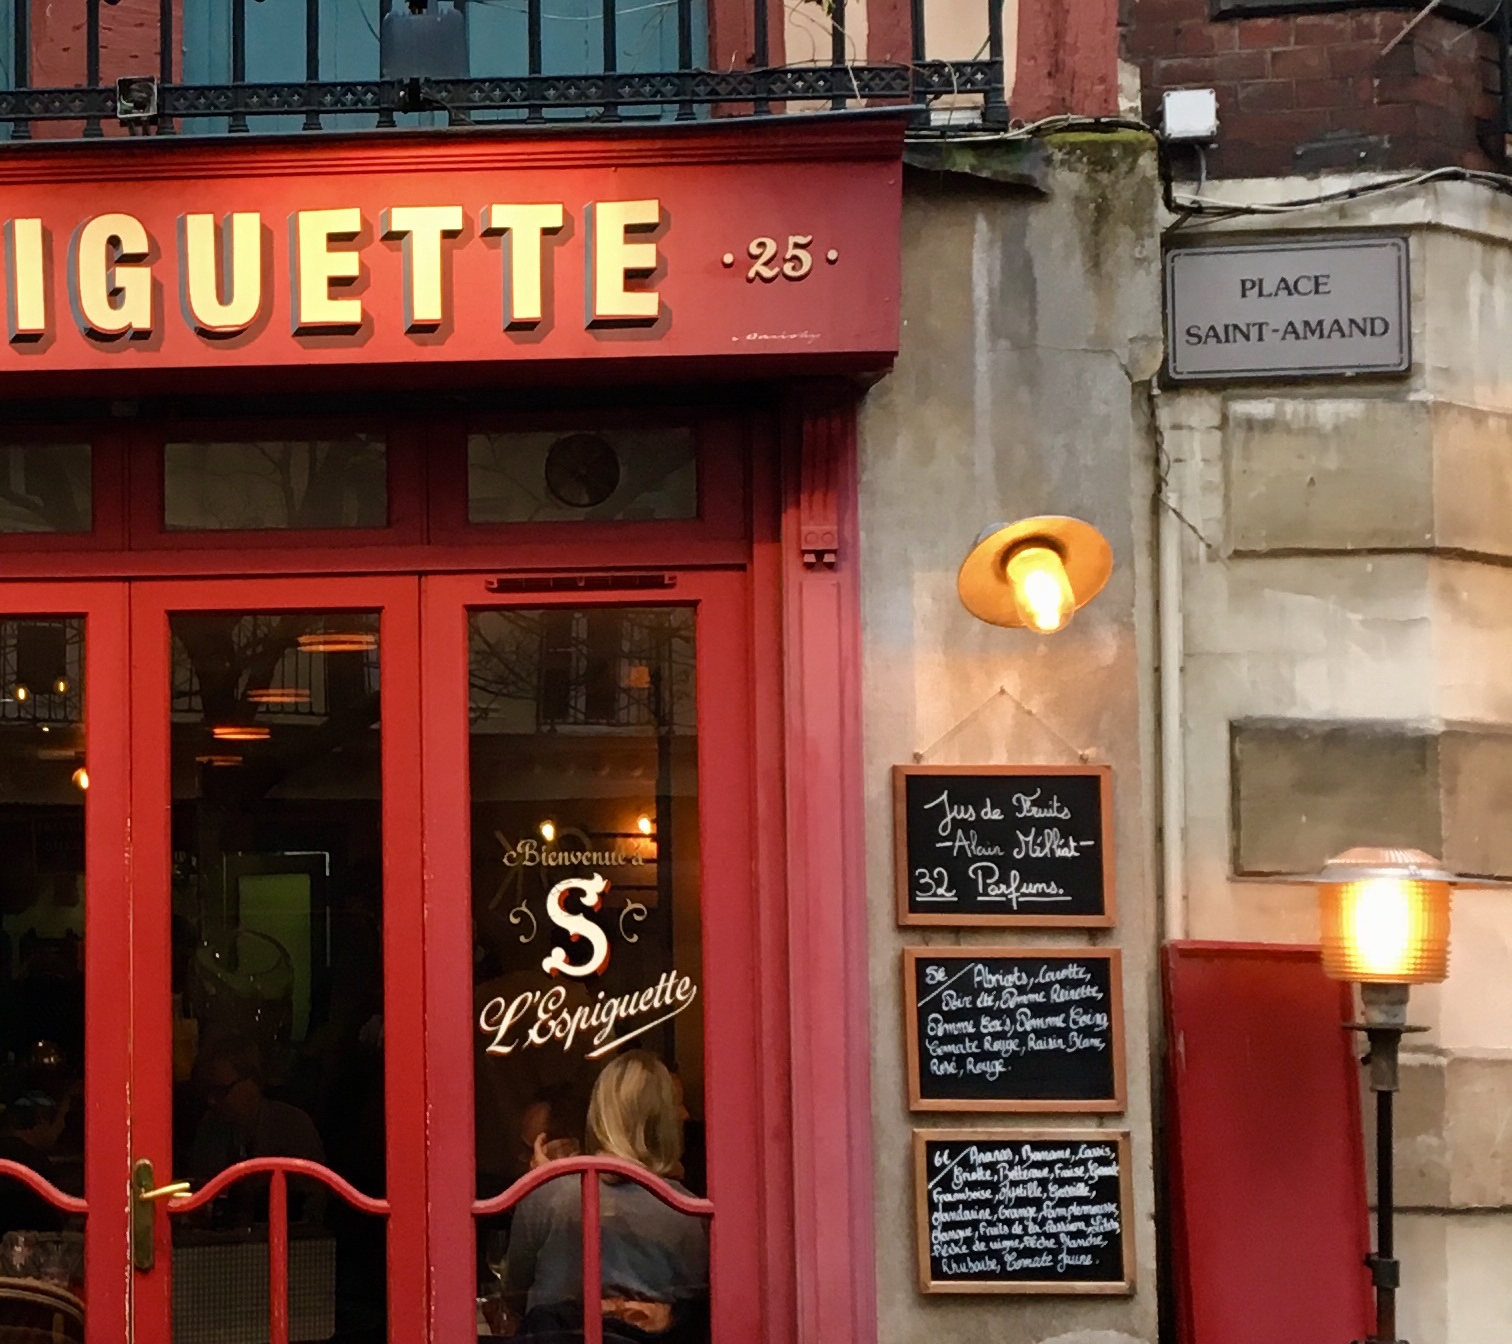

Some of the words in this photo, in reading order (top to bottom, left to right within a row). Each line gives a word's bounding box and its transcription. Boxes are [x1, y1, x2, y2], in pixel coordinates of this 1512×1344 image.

[746, 234, 814, 283] 25
[1240, 274, 1331, 299] PLACE
[1185, 316, 1390, 346] SAINT-AMAND
[923, 790, 976, 836] Jus
[981, 798, 1004, 820] de
[1012, 788, 1072, 819] Fruits
[502, 839, 626, 866] Bienvenue
[915, 867, 957, 899] 32
[542, 872, 612, 977] S
[479, 969, 697, 1055] L'Espiguette
[1028, 1033, 1066, 1051] Raisin
